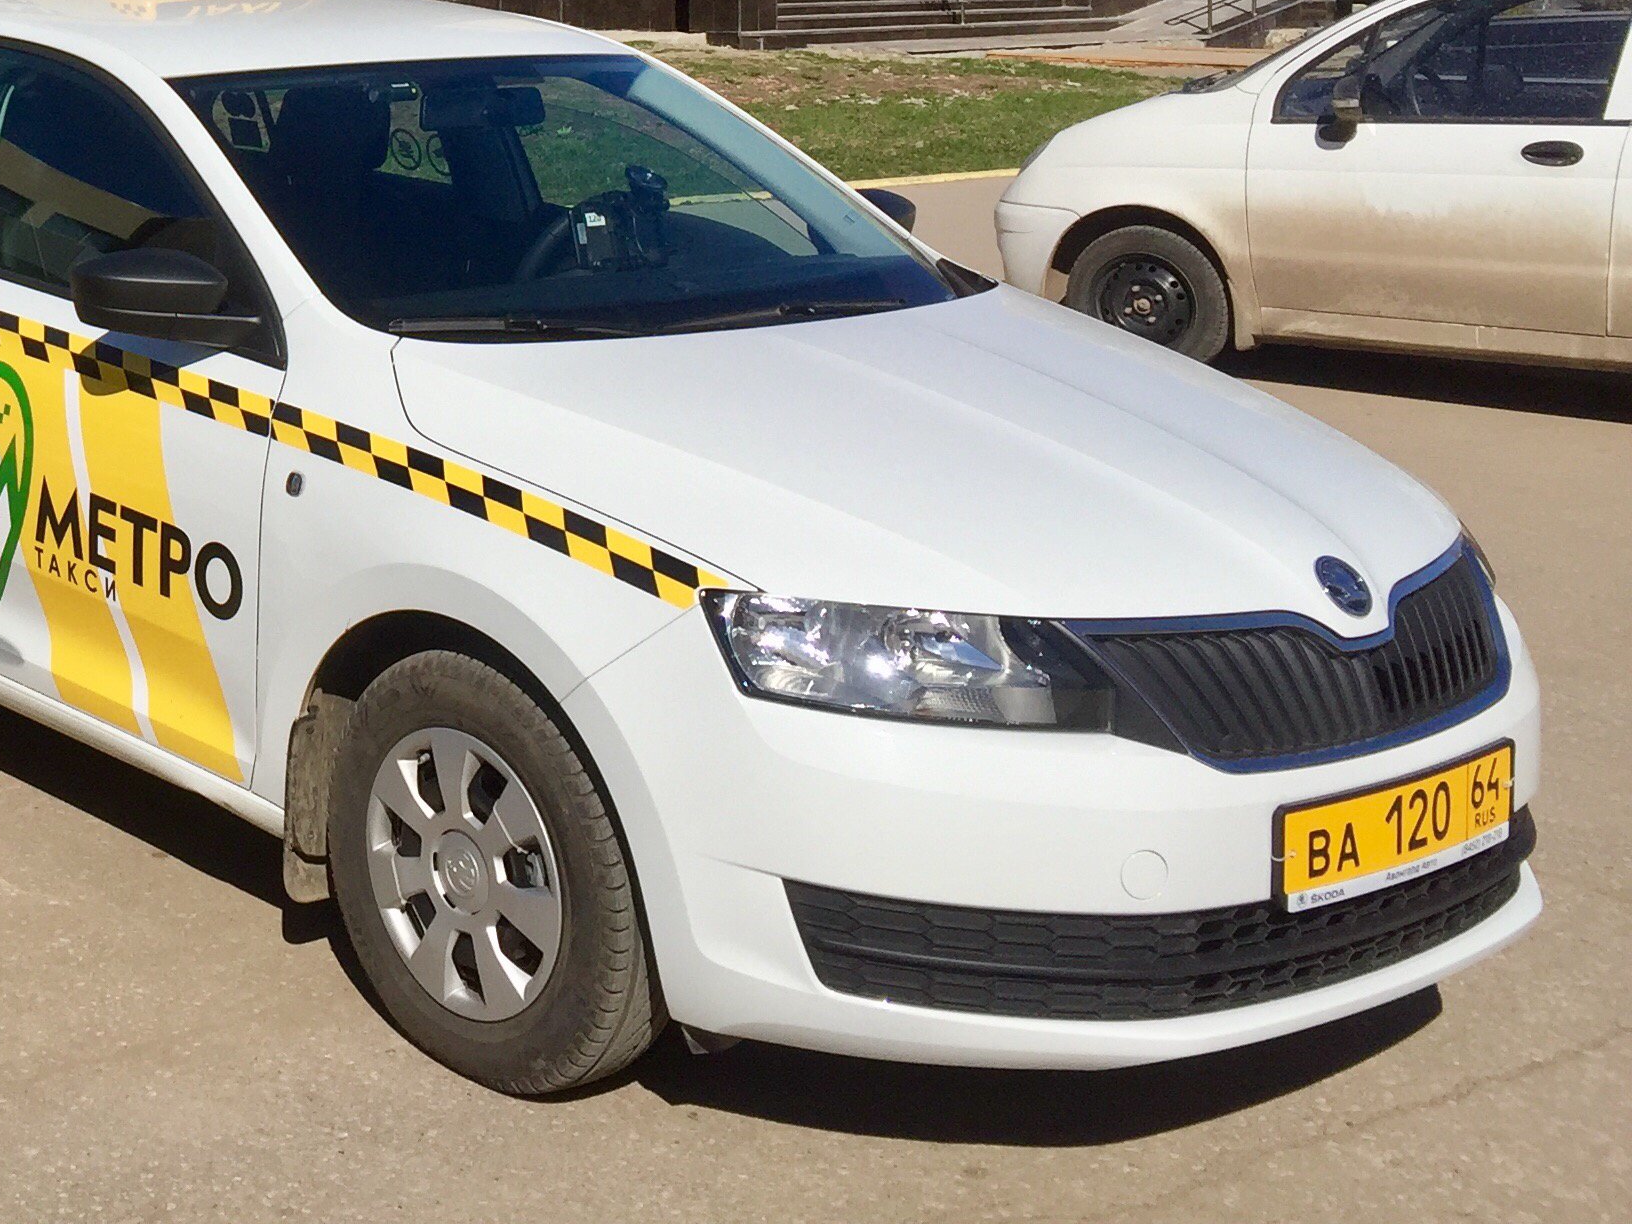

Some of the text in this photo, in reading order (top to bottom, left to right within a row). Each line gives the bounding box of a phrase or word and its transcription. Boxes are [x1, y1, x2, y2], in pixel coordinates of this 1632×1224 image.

[33, 545, 118, 603] ТАКСИ
[34, 475, 243, 621] МЕТРО
[1385, 781, 1451, 855] 120
[1470, 757, 1500, 809] 64
[1474, 807, 1496, 828] RUS
